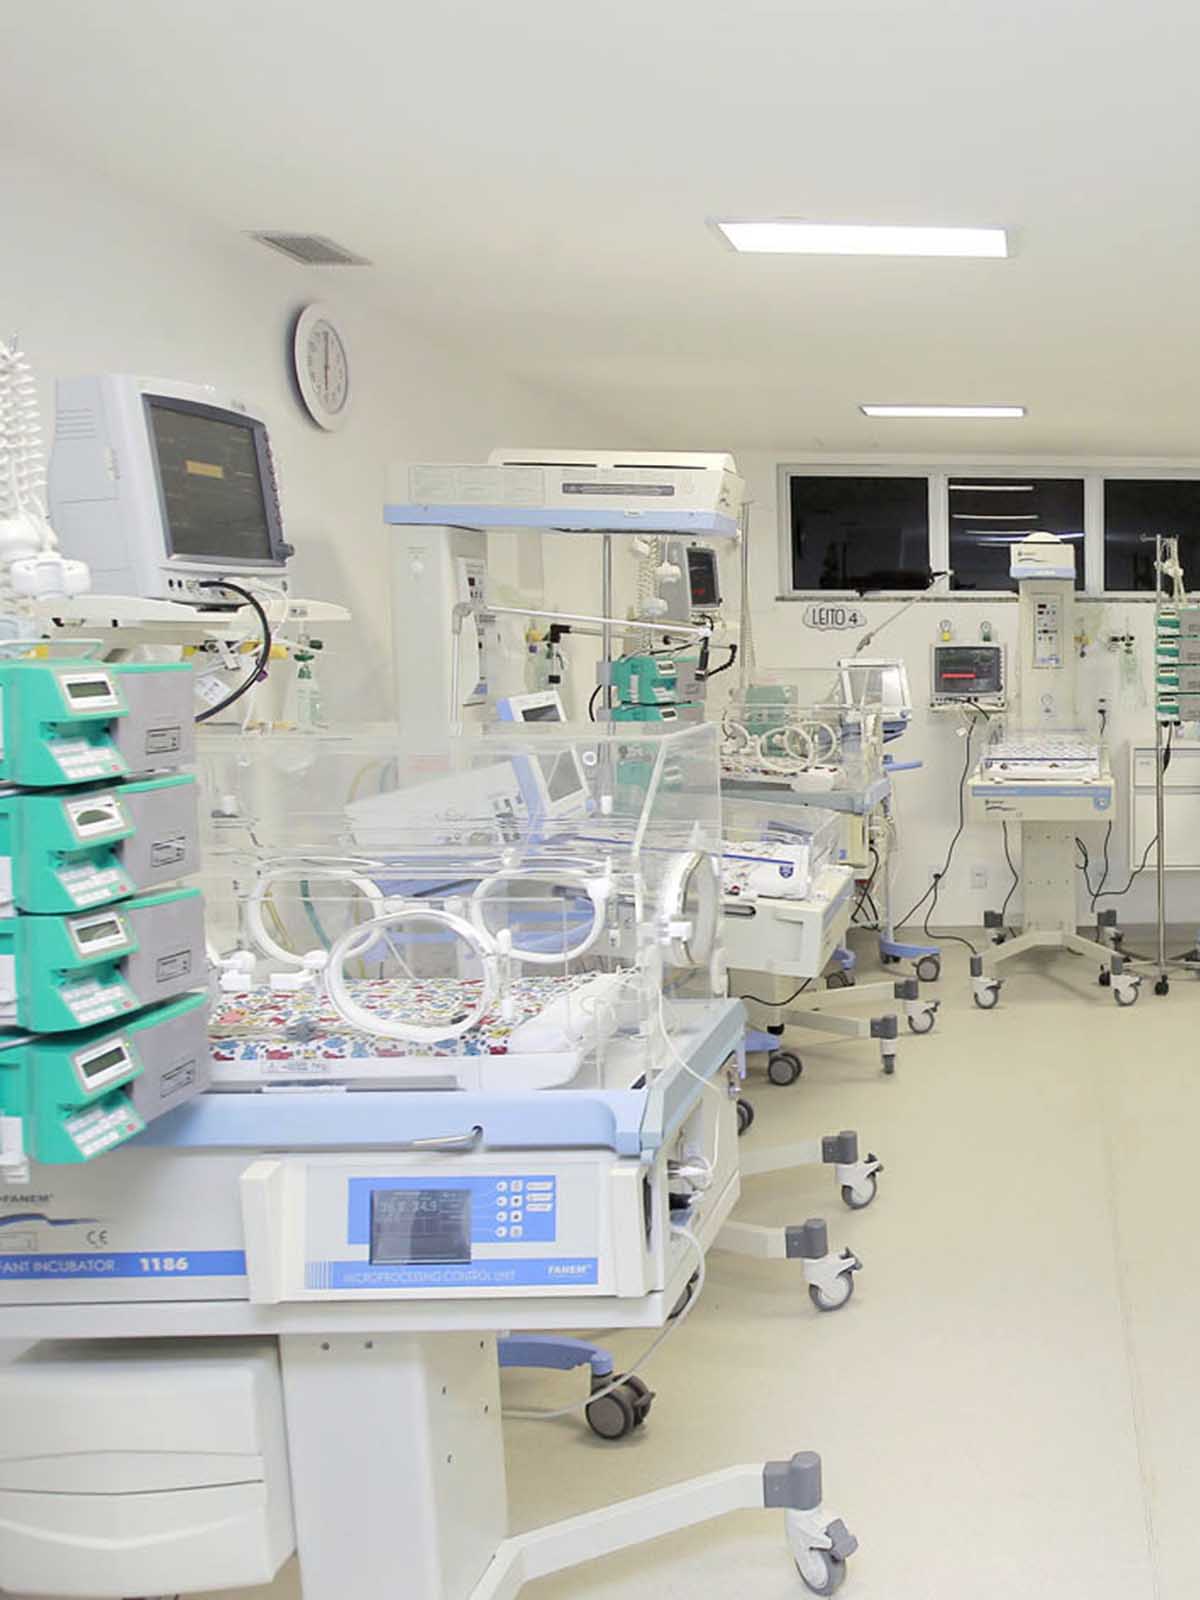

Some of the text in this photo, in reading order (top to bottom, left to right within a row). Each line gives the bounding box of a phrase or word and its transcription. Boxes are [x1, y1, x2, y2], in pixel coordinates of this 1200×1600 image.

[812, 607, 858, 626] LEITO 4
[33, 1258, 115, 1274] INCUBATOR
[138, 1256, 189, 1272] 1186
